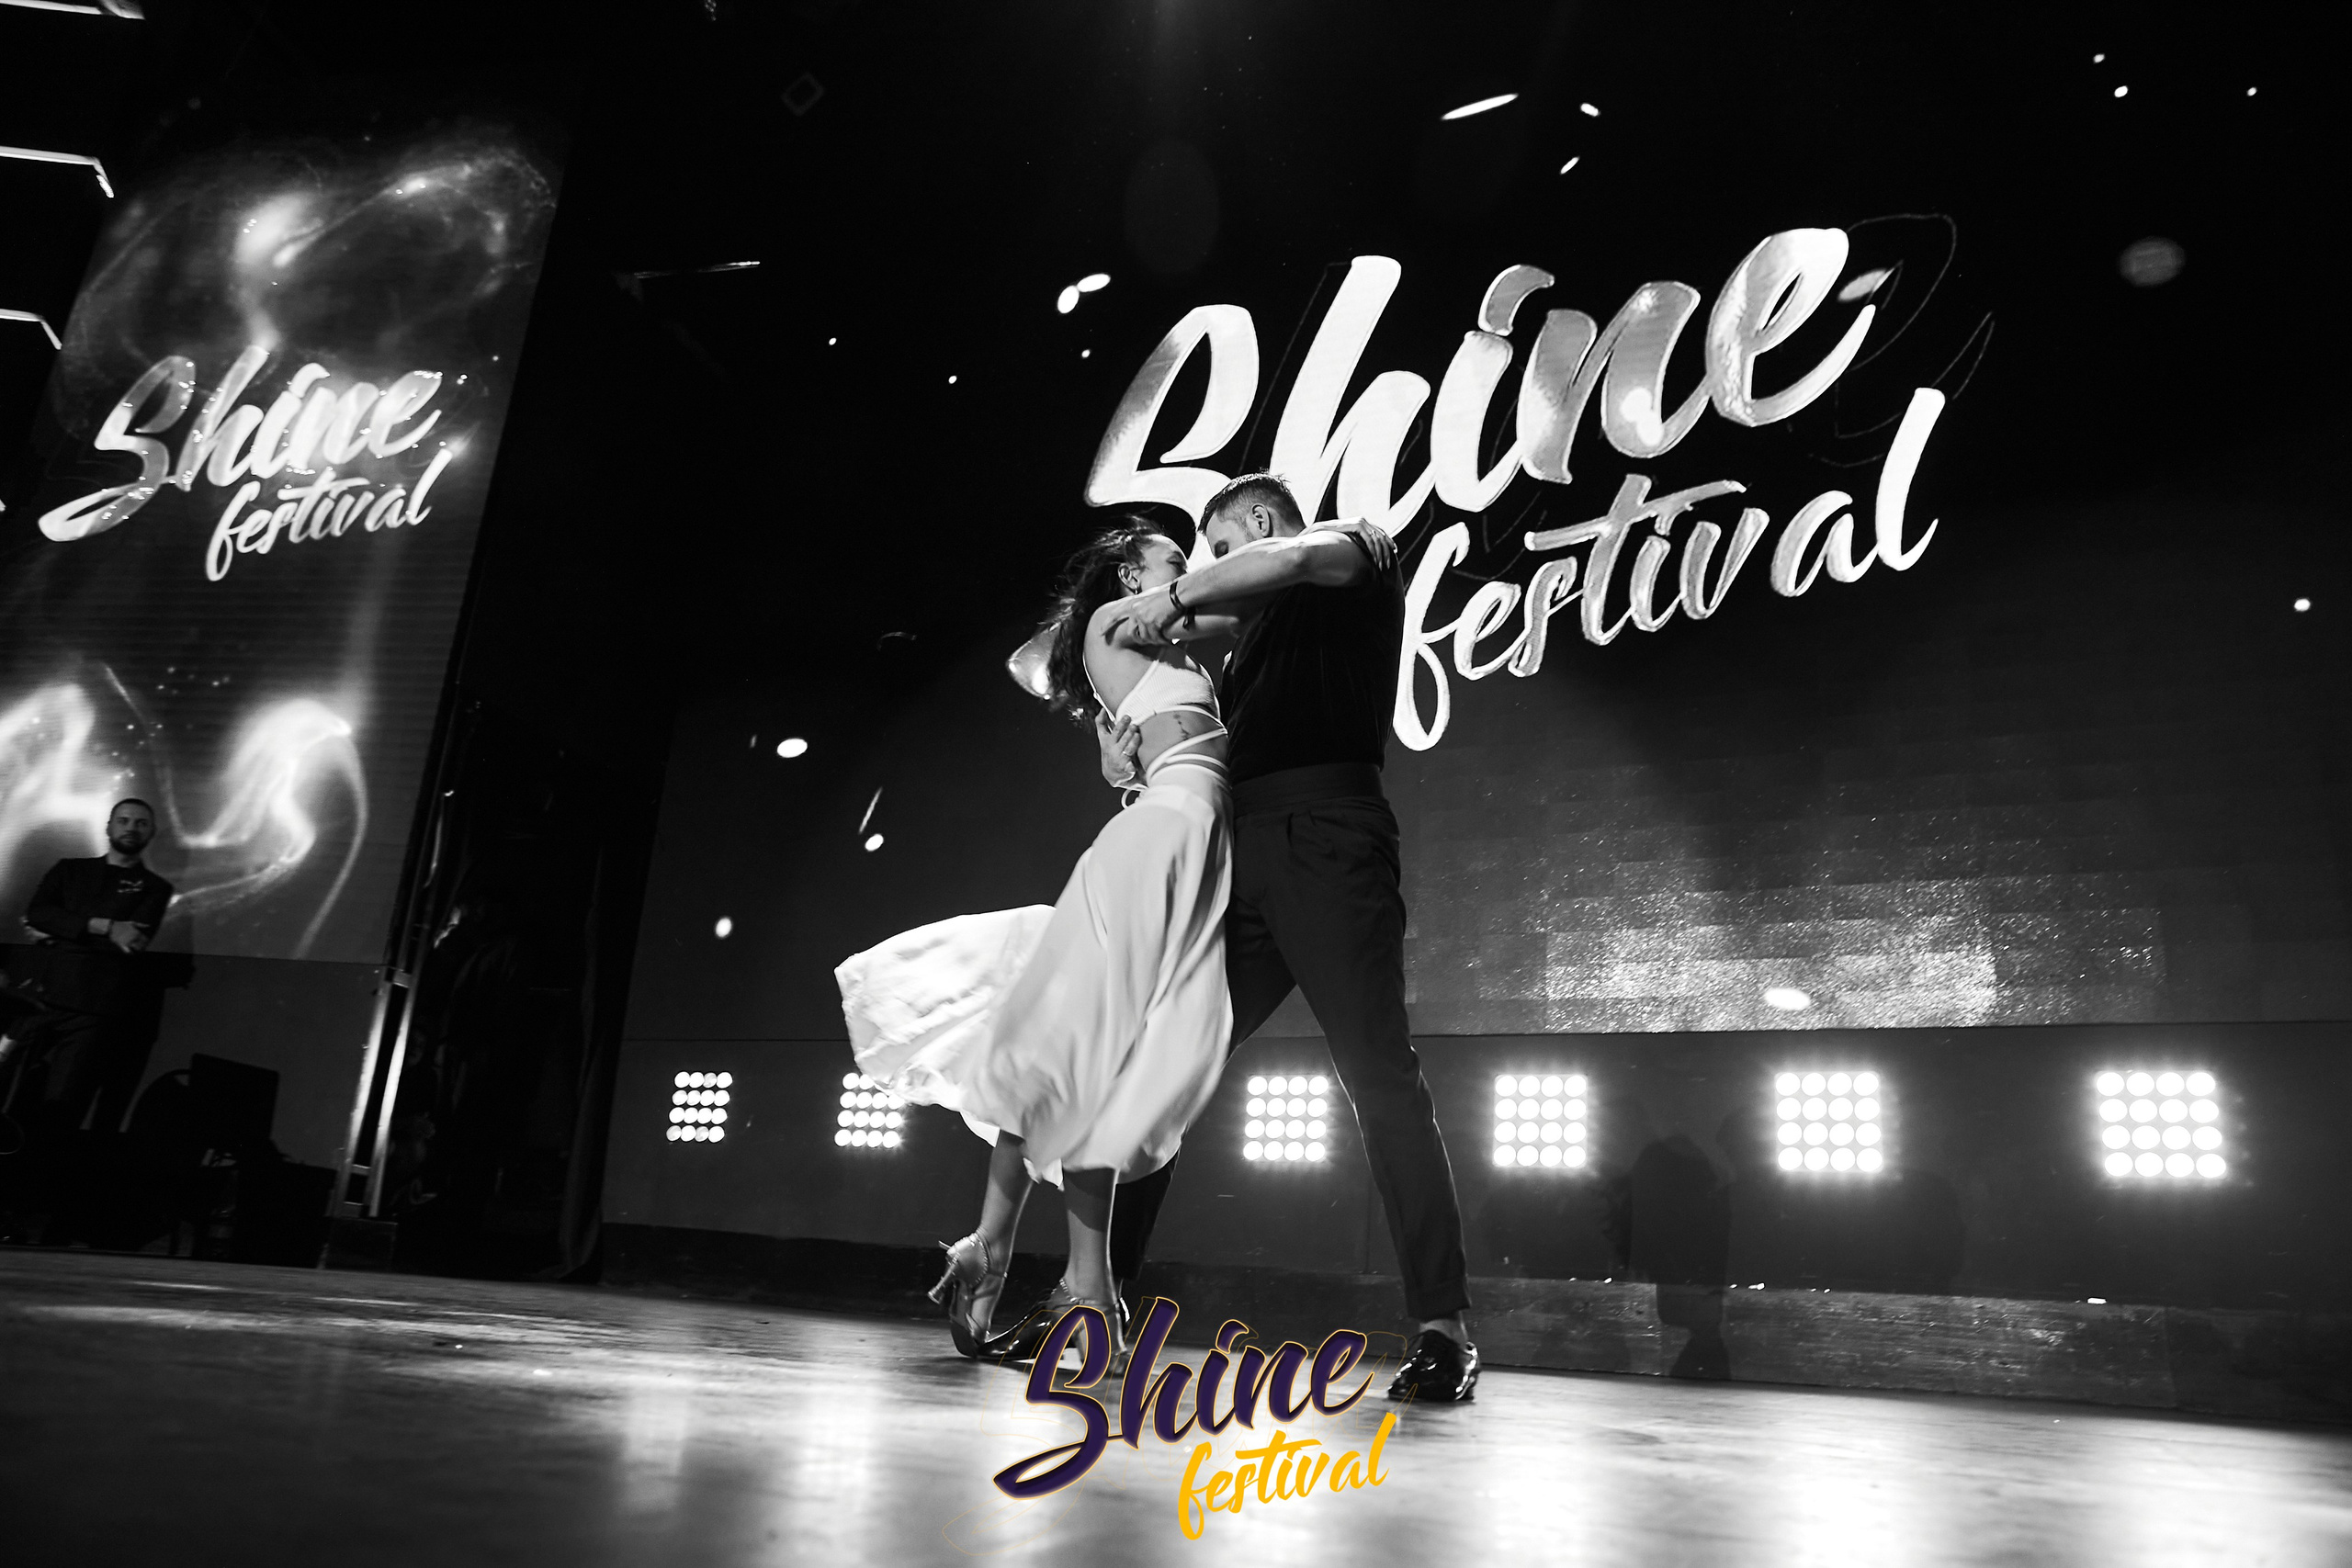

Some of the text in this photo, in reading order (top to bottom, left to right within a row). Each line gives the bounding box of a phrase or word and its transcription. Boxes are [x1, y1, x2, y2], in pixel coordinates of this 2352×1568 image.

[38, 345, 442, 541] Shine
[205, 448, 453, 581] festival
[1007, 228, 1876, 698] Shine
[1393, 387, 1946, 751] festival
